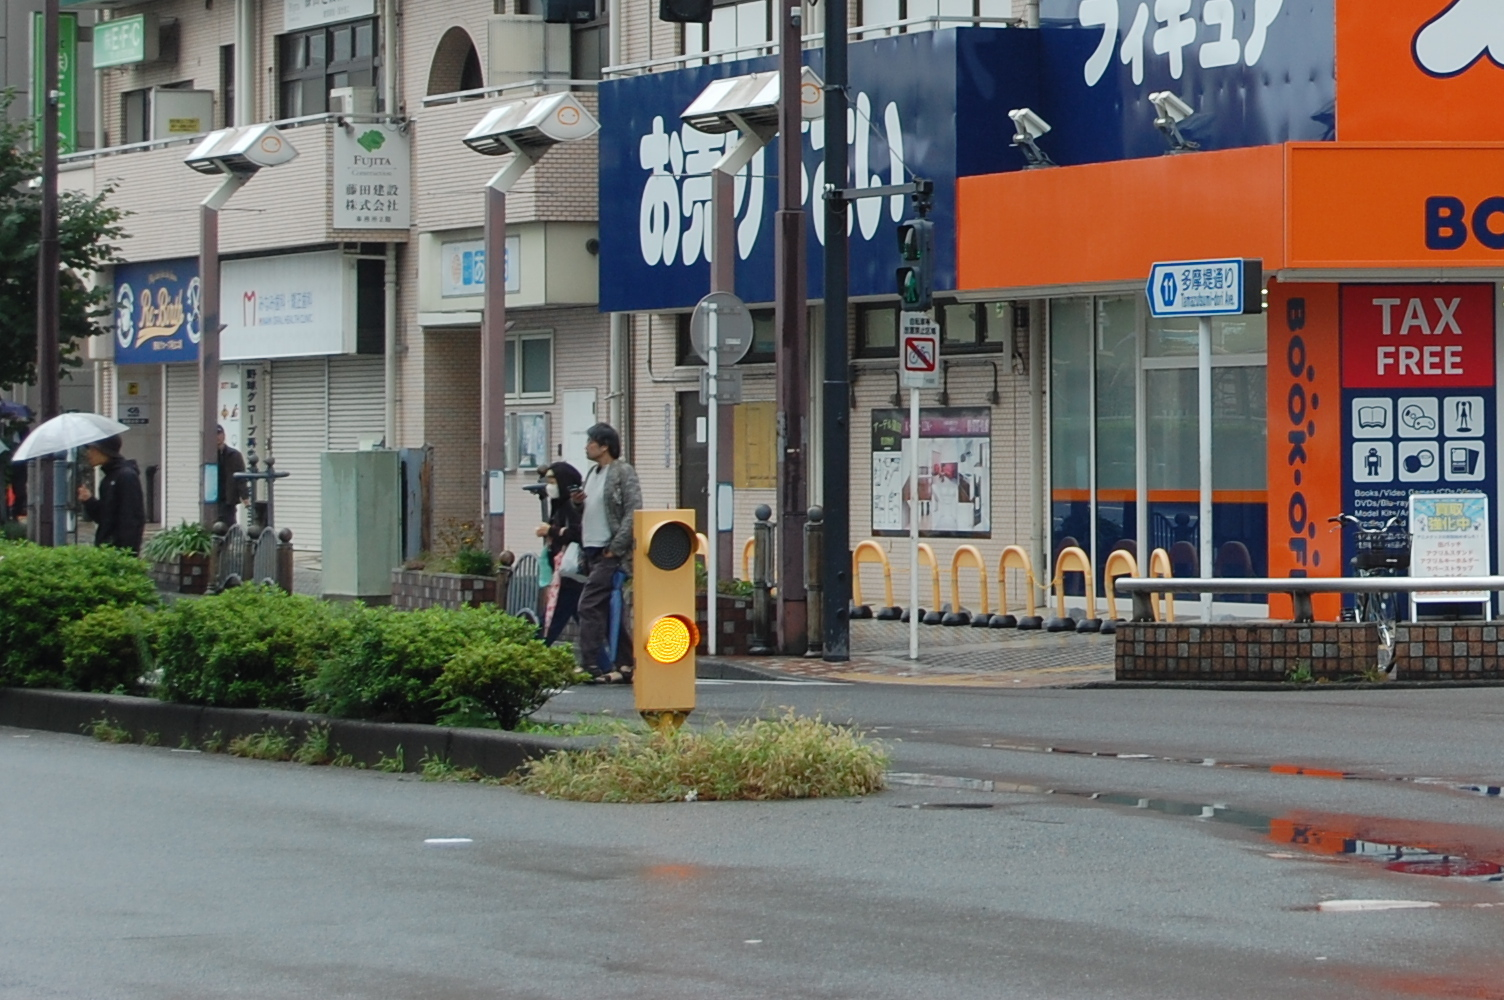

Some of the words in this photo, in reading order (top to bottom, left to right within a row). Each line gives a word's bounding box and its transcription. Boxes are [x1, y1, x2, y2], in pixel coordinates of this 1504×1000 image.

[346, 184, 399, 196] 藤田建設
[346, 199, 399, 211] 株式会社
[1181, 267, 1234, 291] 多摩堤通り
[1372, 297, 1462, 335] TAX
[1377, 345, 1464, 375] FREE
